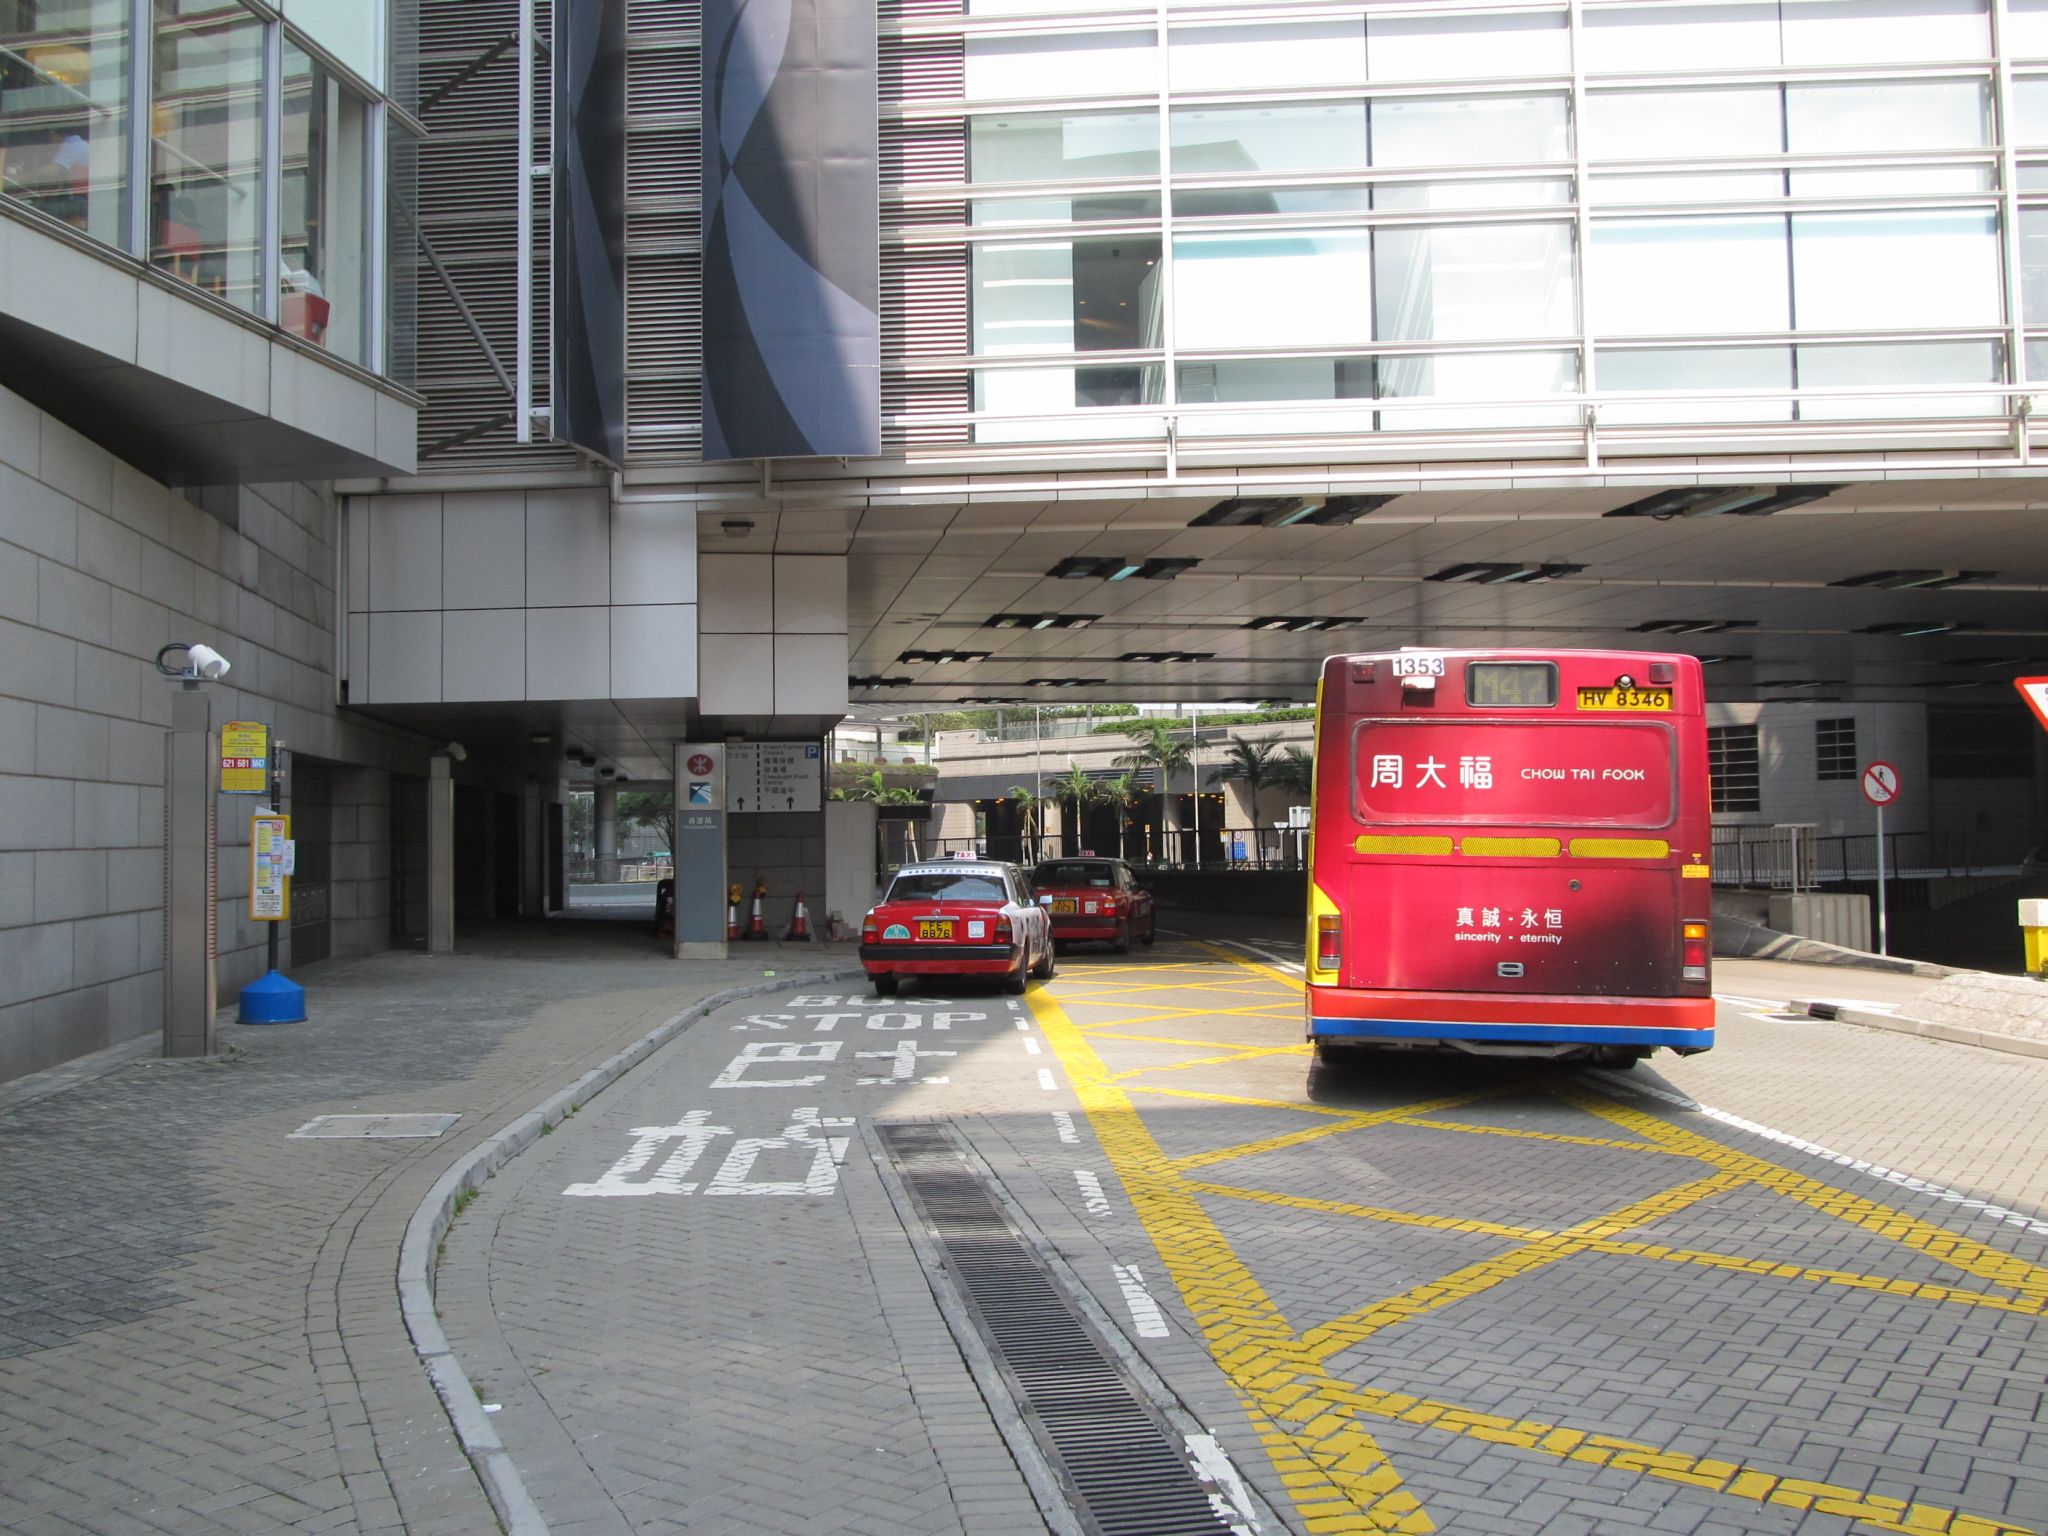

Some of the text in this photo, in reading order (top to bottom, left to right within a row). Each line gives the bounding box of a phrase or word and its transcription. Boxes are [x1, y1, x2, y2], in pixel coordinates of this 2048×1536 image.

[1394, 657, 1443, 675] 1353
[1474, 669, 1546, 704] M47
[1583, 691, 1665, 707] HV 8346
[222, 758, 235, 768] 621
[1371, 754, 1492, 790] 周大福
[1520, 767, 1646, 781] CHOW TAI FOOK
[922, 929, 951, 938] 8876
[1454, 931, 1563, 945] sincerity eternity
[729, 1012, 987, 1032] STOP
[708, 1040, 958, 1088] 巴士
[561, 1106, 857, 1197] 站
